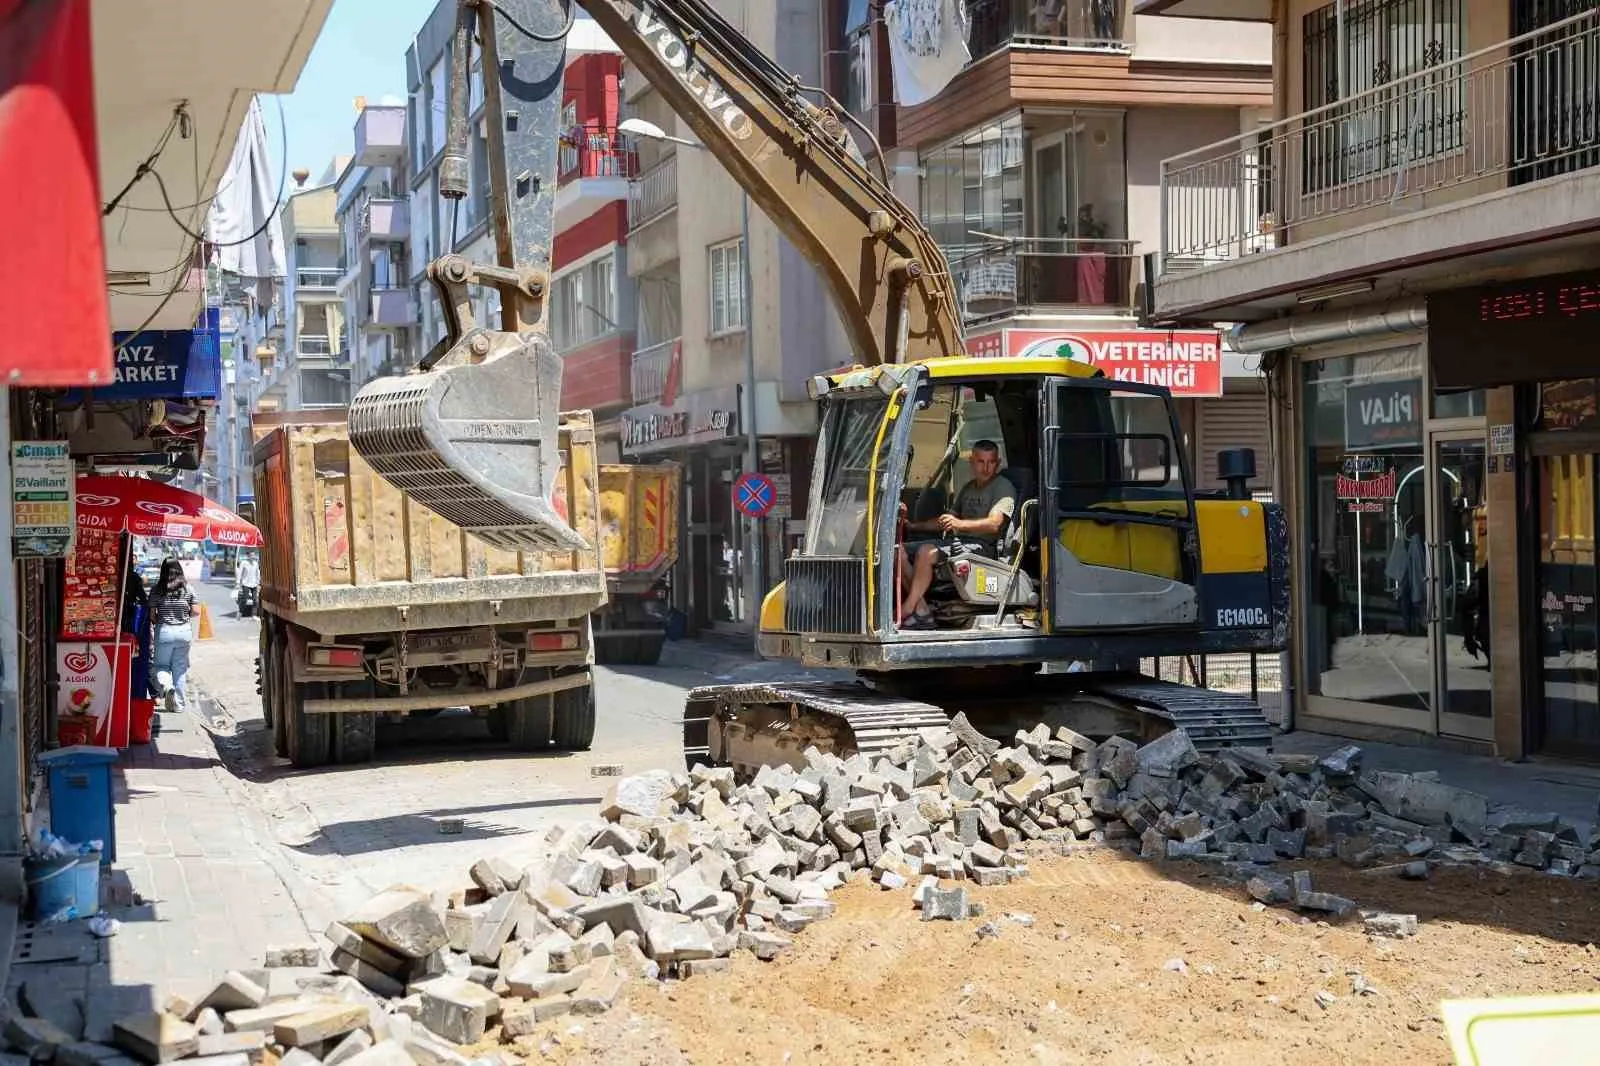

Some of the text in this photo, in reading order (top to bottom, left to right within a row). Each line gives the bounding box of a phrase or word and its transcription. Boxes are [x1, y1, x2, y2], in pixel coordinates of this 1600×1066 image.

[637, 3, 752, 140] VOLVO
[1092, 337, 1217, 362] VETERİNER
[1114, 363, 1196, 387] KLİNİĞİ
[26, 477, 66, 488] Vaillant
